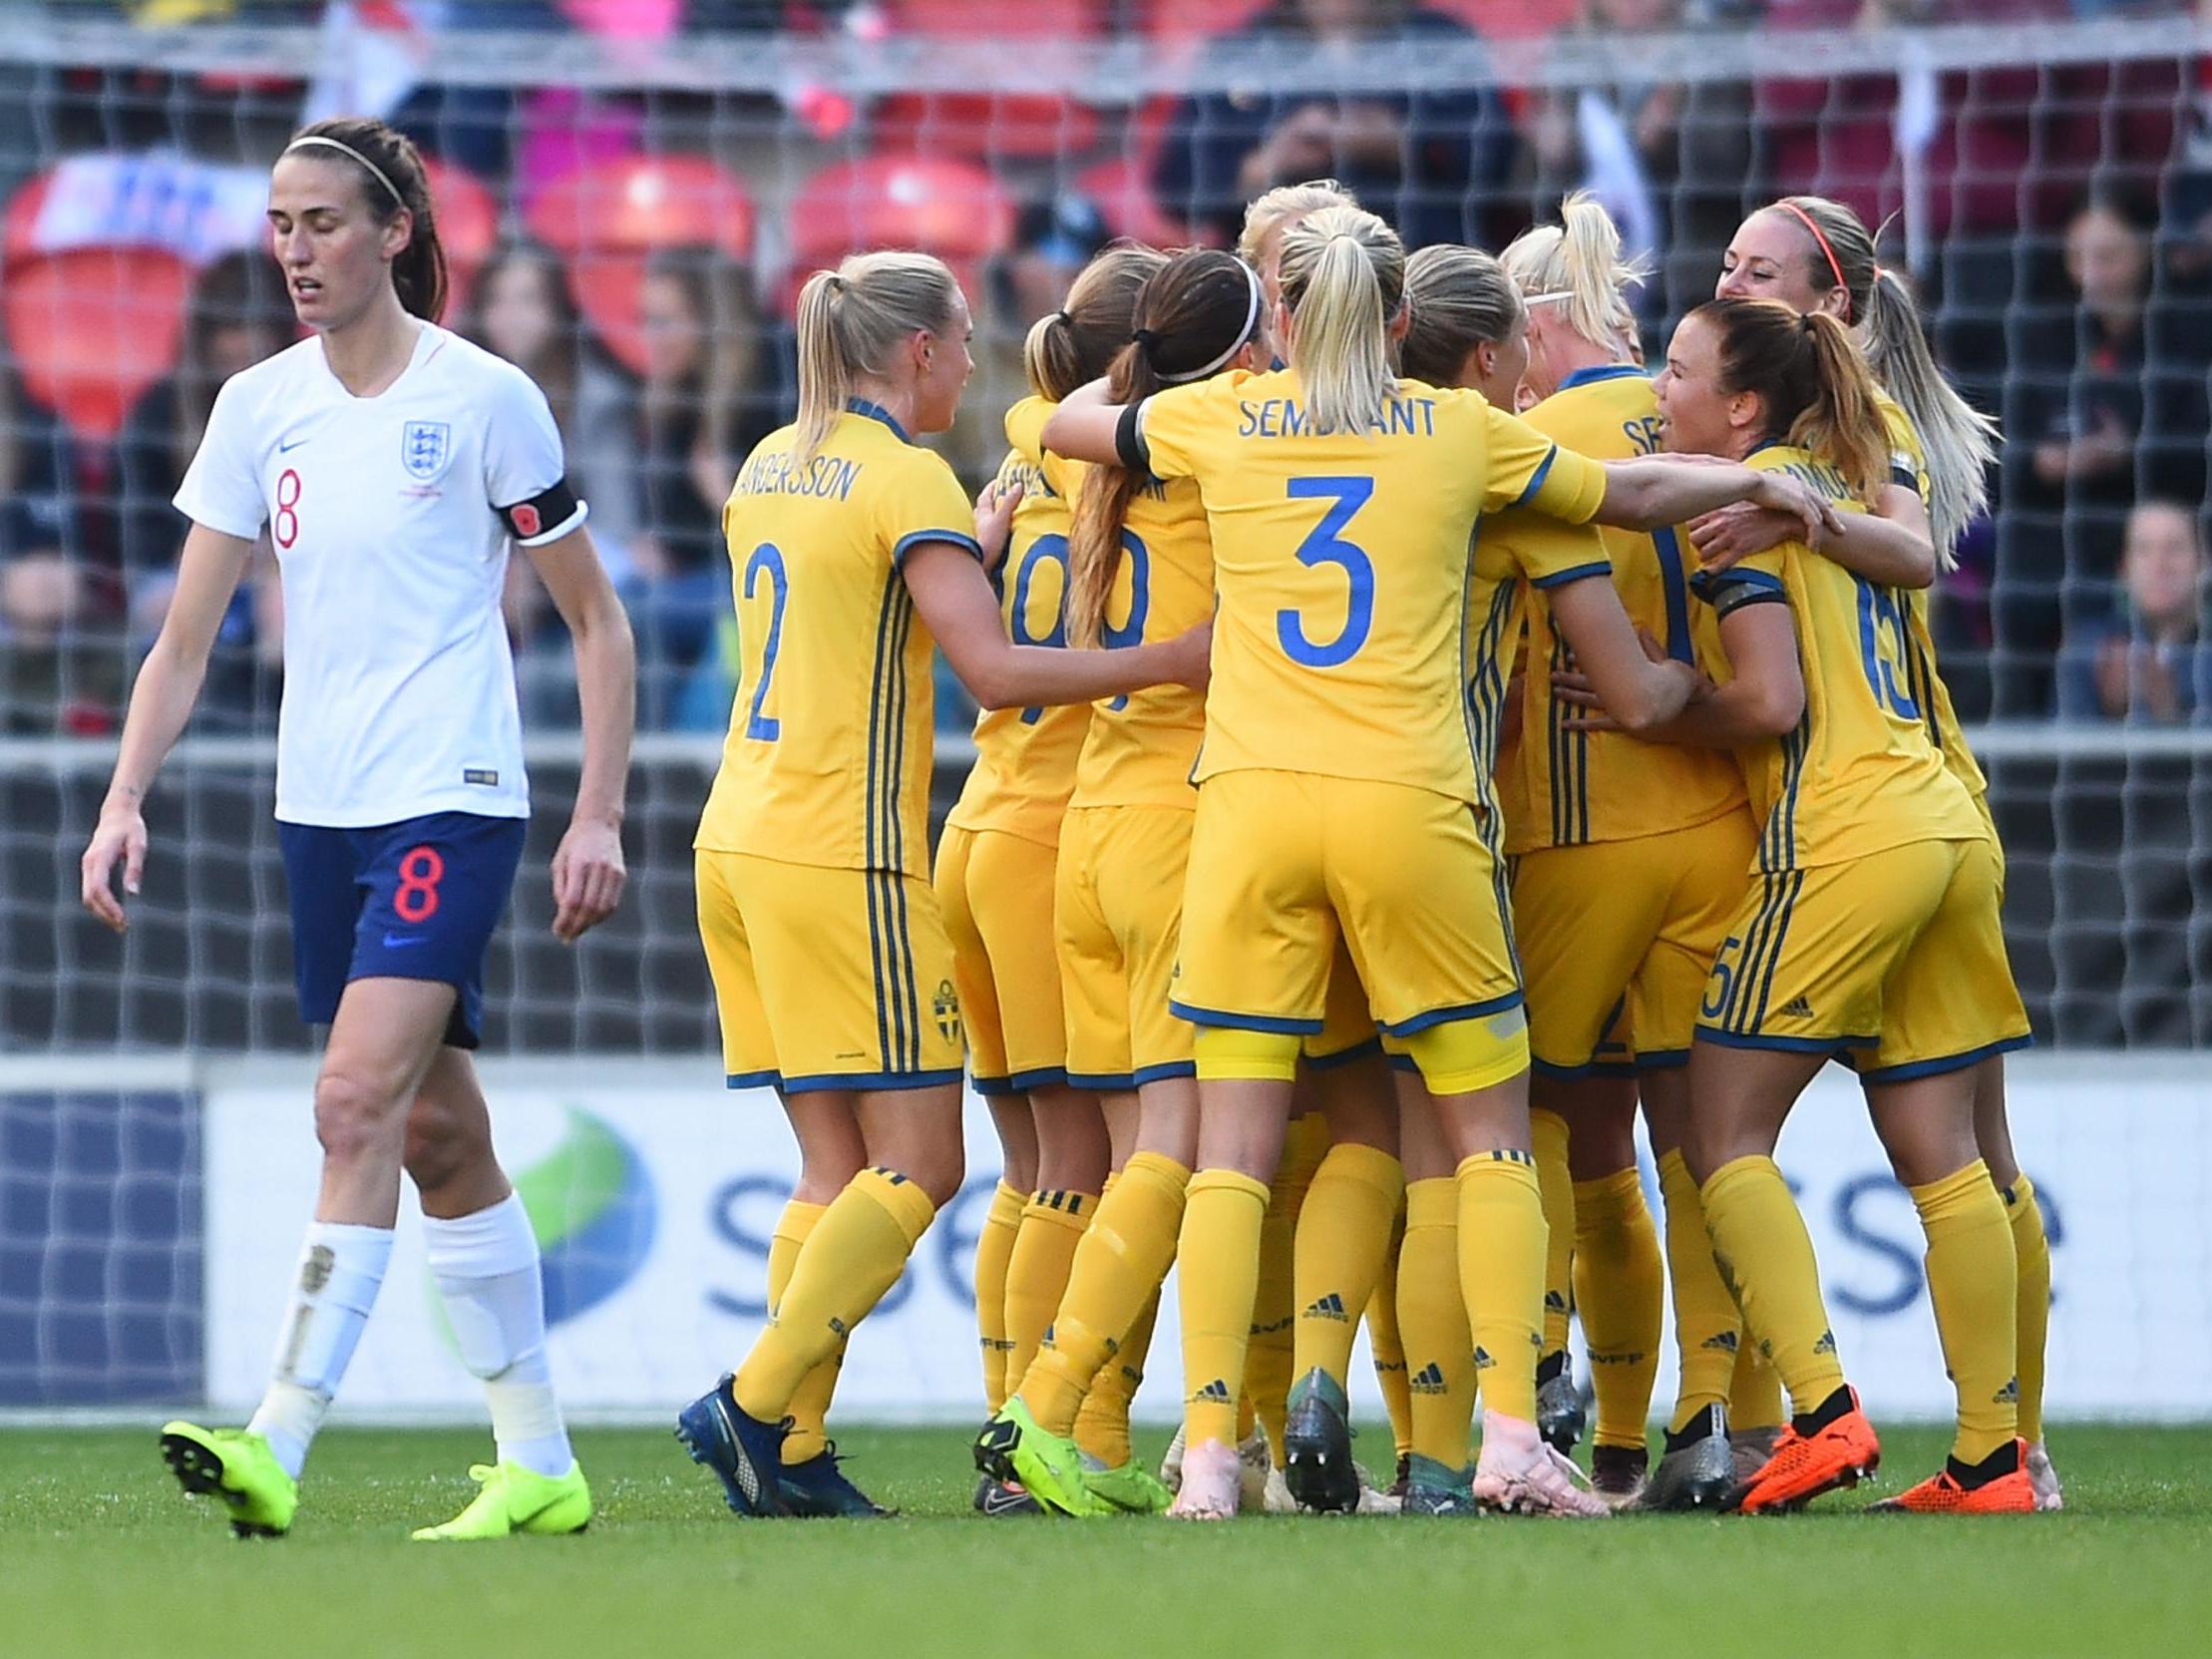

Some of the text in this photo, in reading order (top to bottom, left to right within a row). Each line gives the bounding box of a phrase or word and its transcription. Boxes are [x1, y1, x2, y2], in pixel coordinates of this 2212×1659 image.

[274, 468, 301, 550] 8
[1277, 476, 1374, 667] 3
[744, 542, 788, 742] 2
[394, 844, 446, 924] 8
